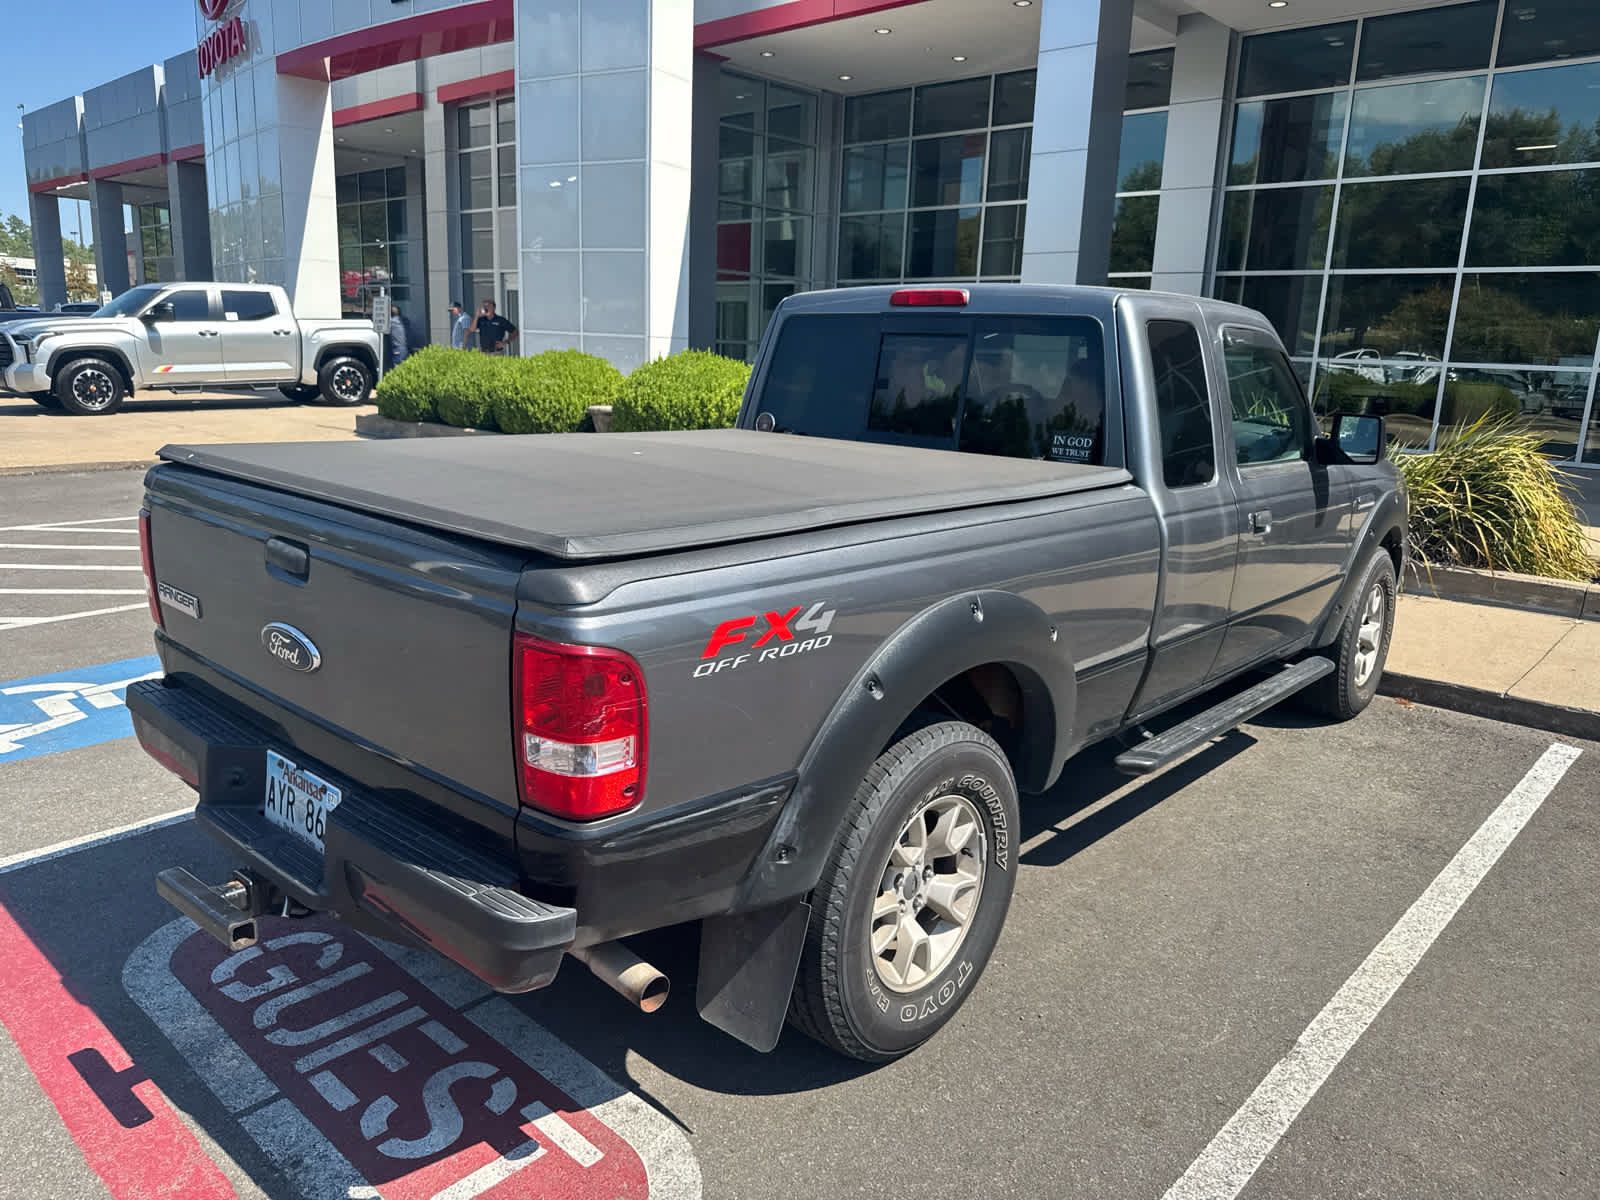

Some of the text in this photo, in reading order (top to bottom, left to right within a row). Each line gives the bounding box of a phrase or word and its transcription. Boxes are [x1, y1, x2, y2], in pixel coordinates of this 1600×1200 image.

[197, 16, 245, 79] TOYOTA
[1052, 447, 1090, 457] WE TRUST
[1053, 435, 1092, 447] IN GOD
[158, 583, 196, 609] RANGER
[268, 631, 300, 665] Ford
[700, 601, 836, 660] FX4
[692, 635, 833, 678] OFF ROAD
[267, 775, 296, 824] AYR
[283, 763, 324, 802] Arkansas
[957, 774, 1009, 871] COUNTRY
[900, 960, 974, 1022] TOYO
[210, 930, 606, 1200] GUEST
